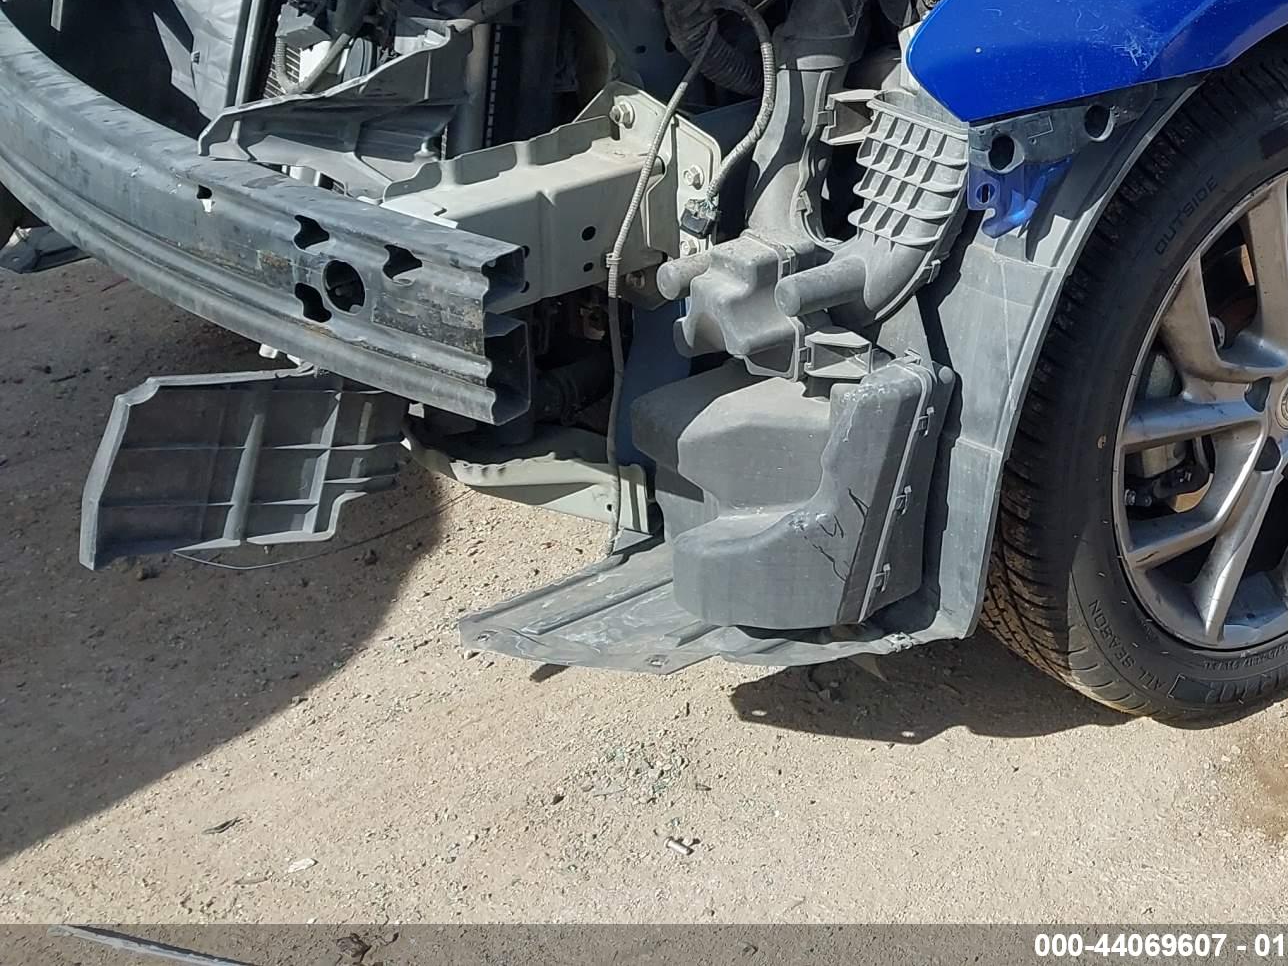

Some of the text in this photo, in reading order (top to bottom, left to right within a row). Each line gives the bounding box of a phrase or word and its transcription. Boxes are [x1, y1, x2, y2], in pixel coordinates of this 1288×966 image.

[1154, 174, 1219, 256] OUTSIDE
[1088, 599, 1136, 668] SEASON
[1139, 666, 1166, 691] ALL
